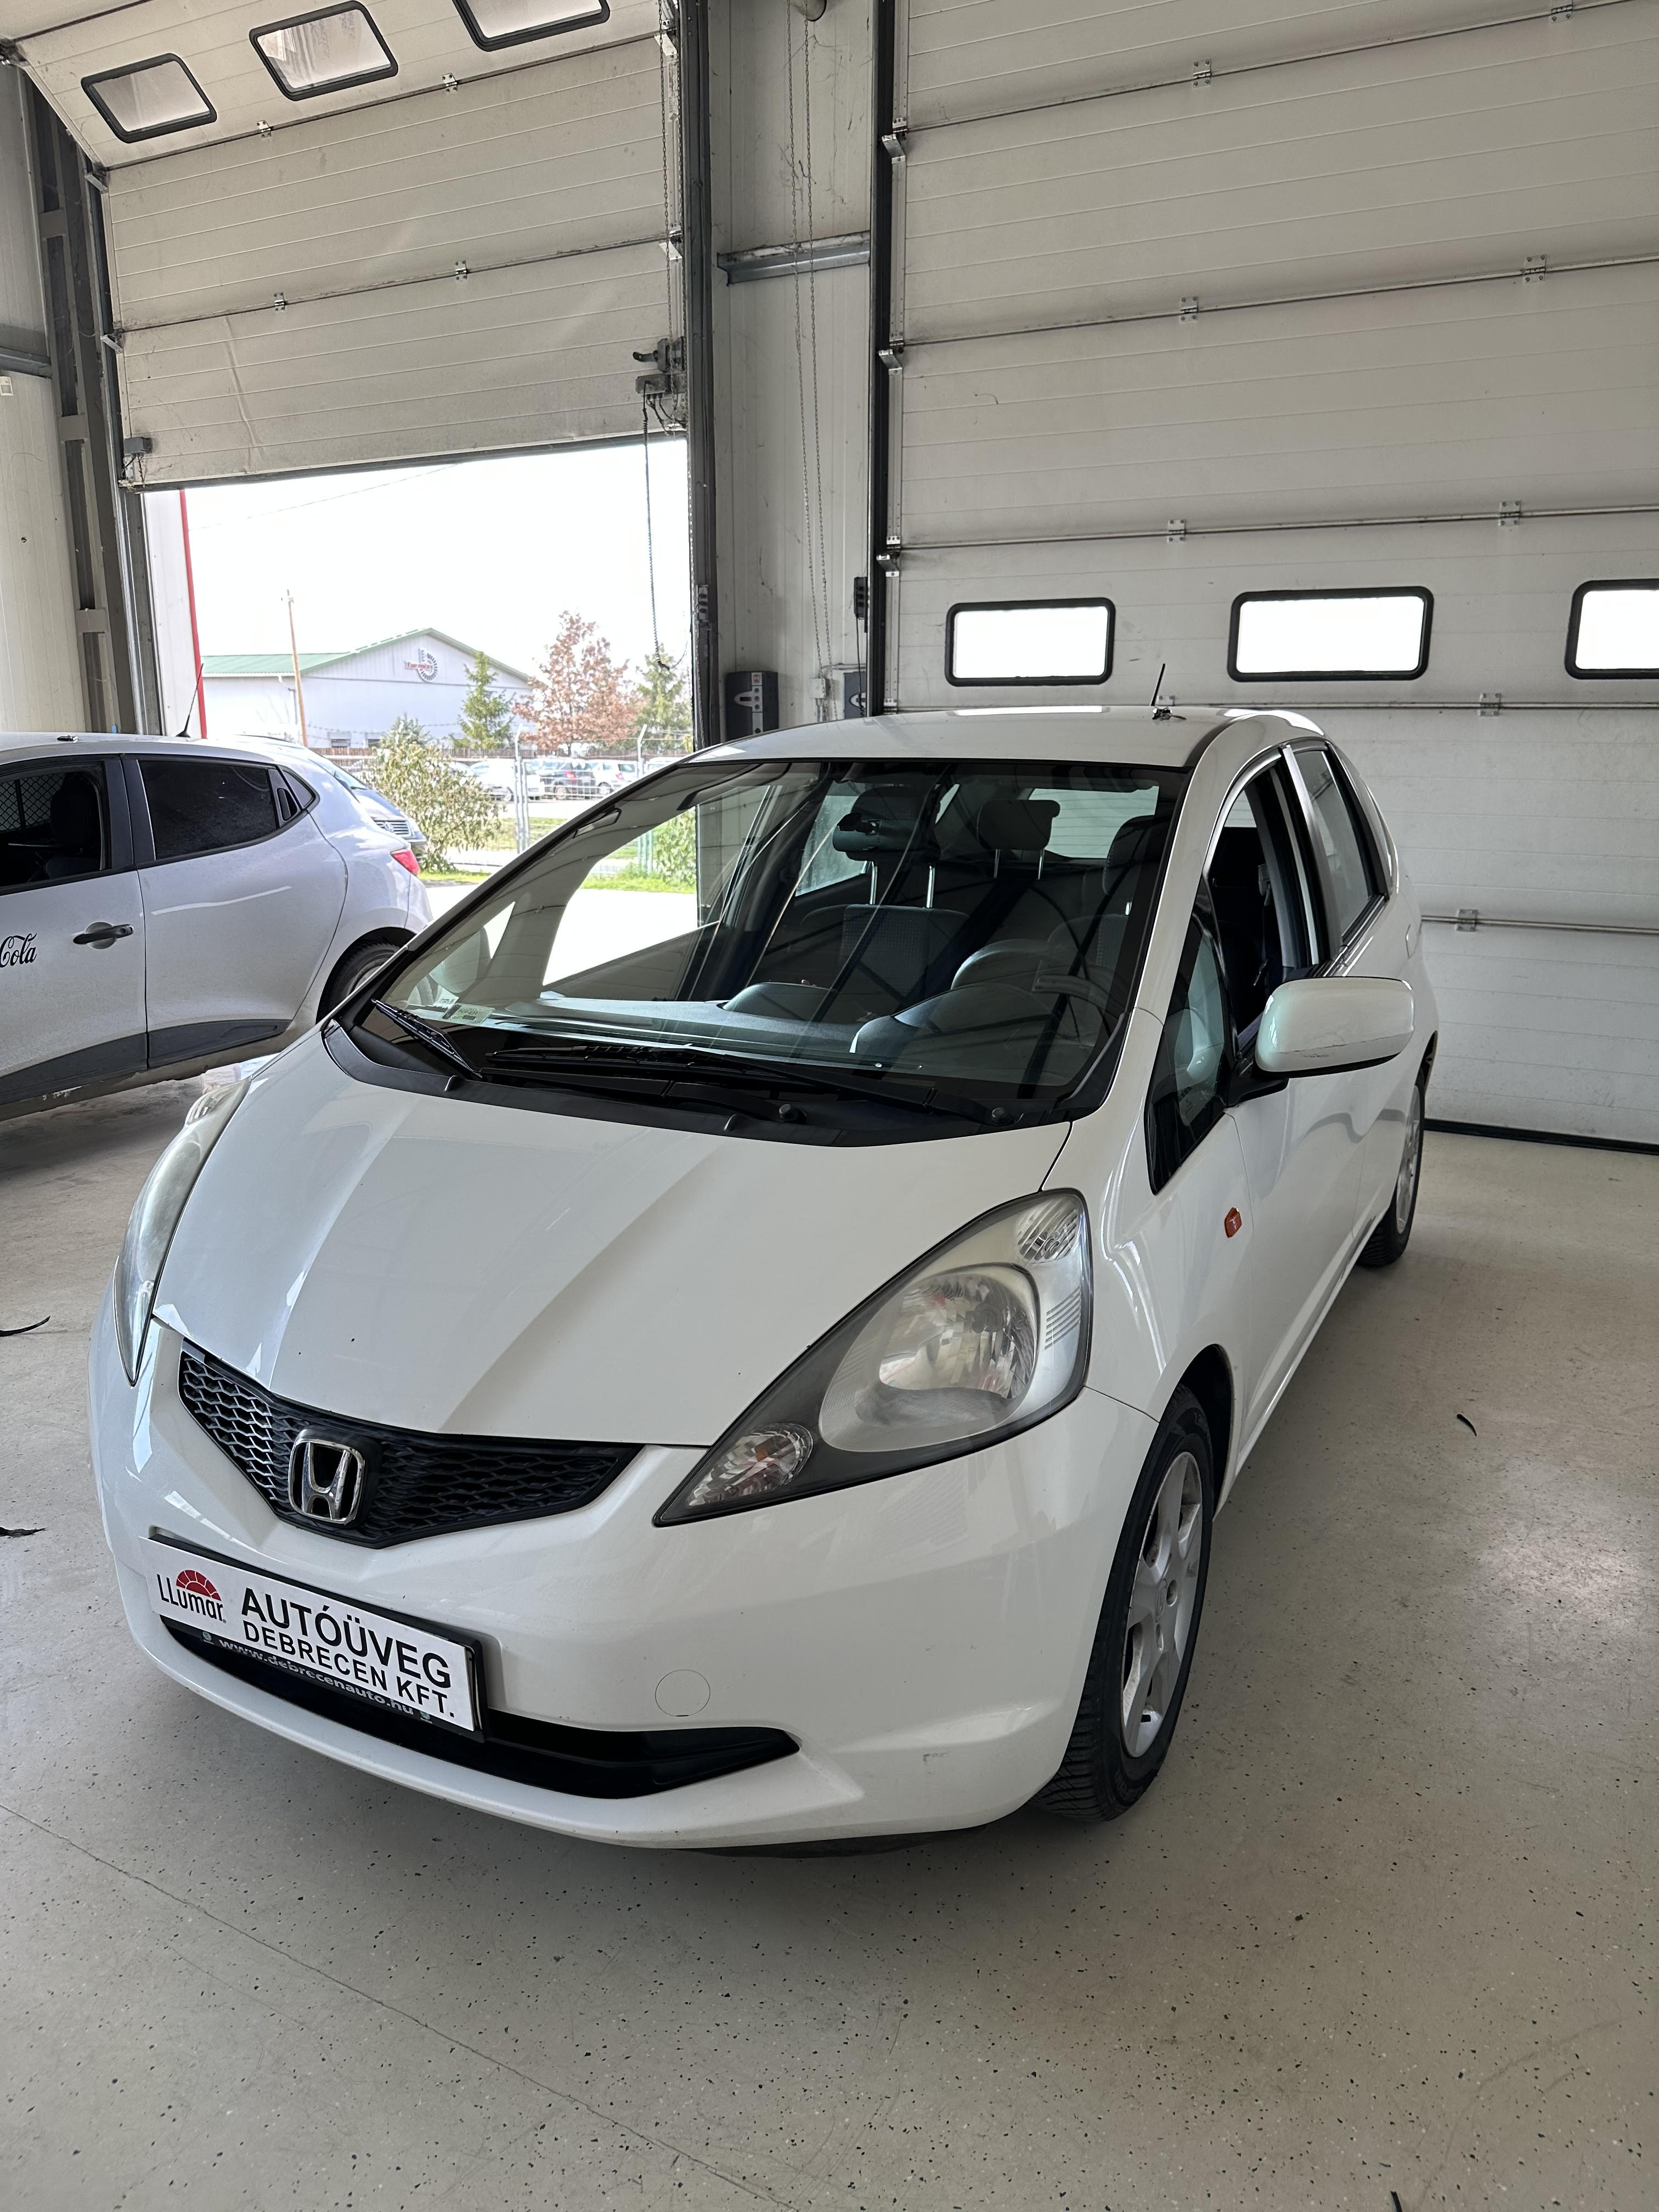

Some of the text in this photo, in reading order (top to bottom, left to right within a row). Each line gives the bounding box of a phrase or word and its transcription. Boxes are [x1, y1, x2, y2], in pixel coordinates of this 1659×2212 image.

[0, 933, 37, 968] Cola
[157, 1573, 224, 1622] LLumar
[241, 1587, 452, 1689] AUTÓÜVEG
[243, 1620, 455, 1718] DEBRECEN KFT.
[218, 1639, 414, 1716] www.debrecenauto.hu
